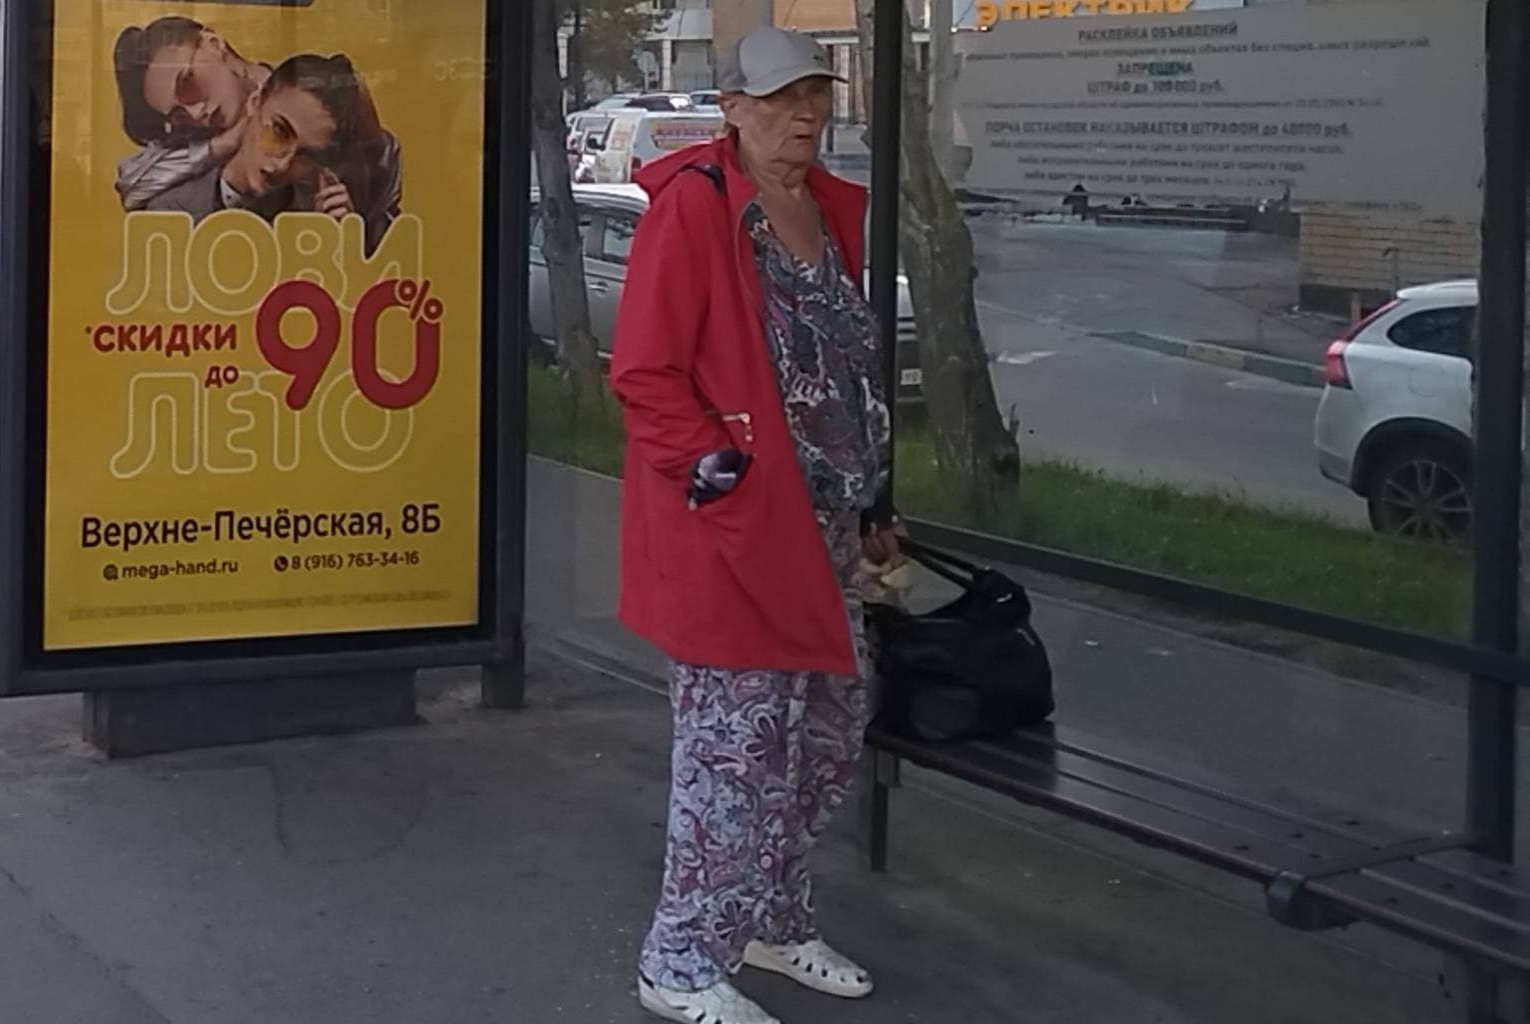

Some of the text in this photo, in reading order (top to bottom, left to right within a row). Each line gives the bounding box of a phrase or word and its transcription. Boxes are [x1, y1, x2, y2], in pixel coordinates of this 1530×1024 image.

[1078, 20, 1238, 42] РАСКЛЕЙКА ОБЪЯВЛЕНИЙ
[1117, 61, 1193, 76] ЗАПРЕЩЕНА
[1191, 121, 1260, 135] ШТРАФОМ
[105, 209, 423, 315] ЛОВИ
[109, 368, 415, 479] ЛЕТО
[81, 503, 442, 552] Верхне-Печёрская, 8Б
[290, 550, 420, 571] 8 (916) 763-34-16
